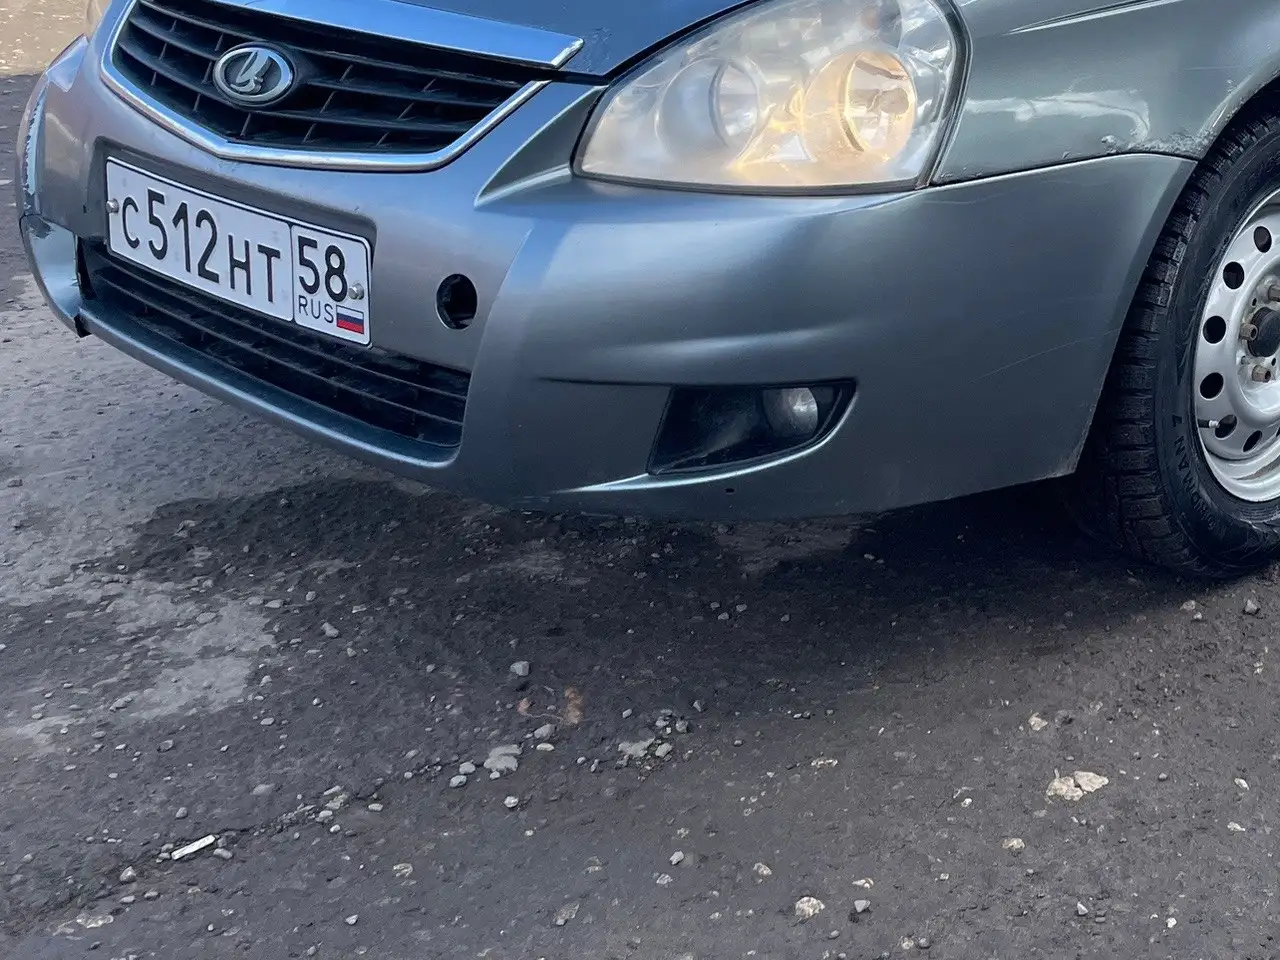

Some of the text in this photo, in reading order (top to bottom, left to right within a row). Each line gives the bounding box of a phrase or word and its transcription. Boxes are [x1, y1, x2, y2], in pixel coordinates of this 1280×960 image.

[121, 187, 348, 303] С512НТ 58
[298, 295, 335, 324] RUS
